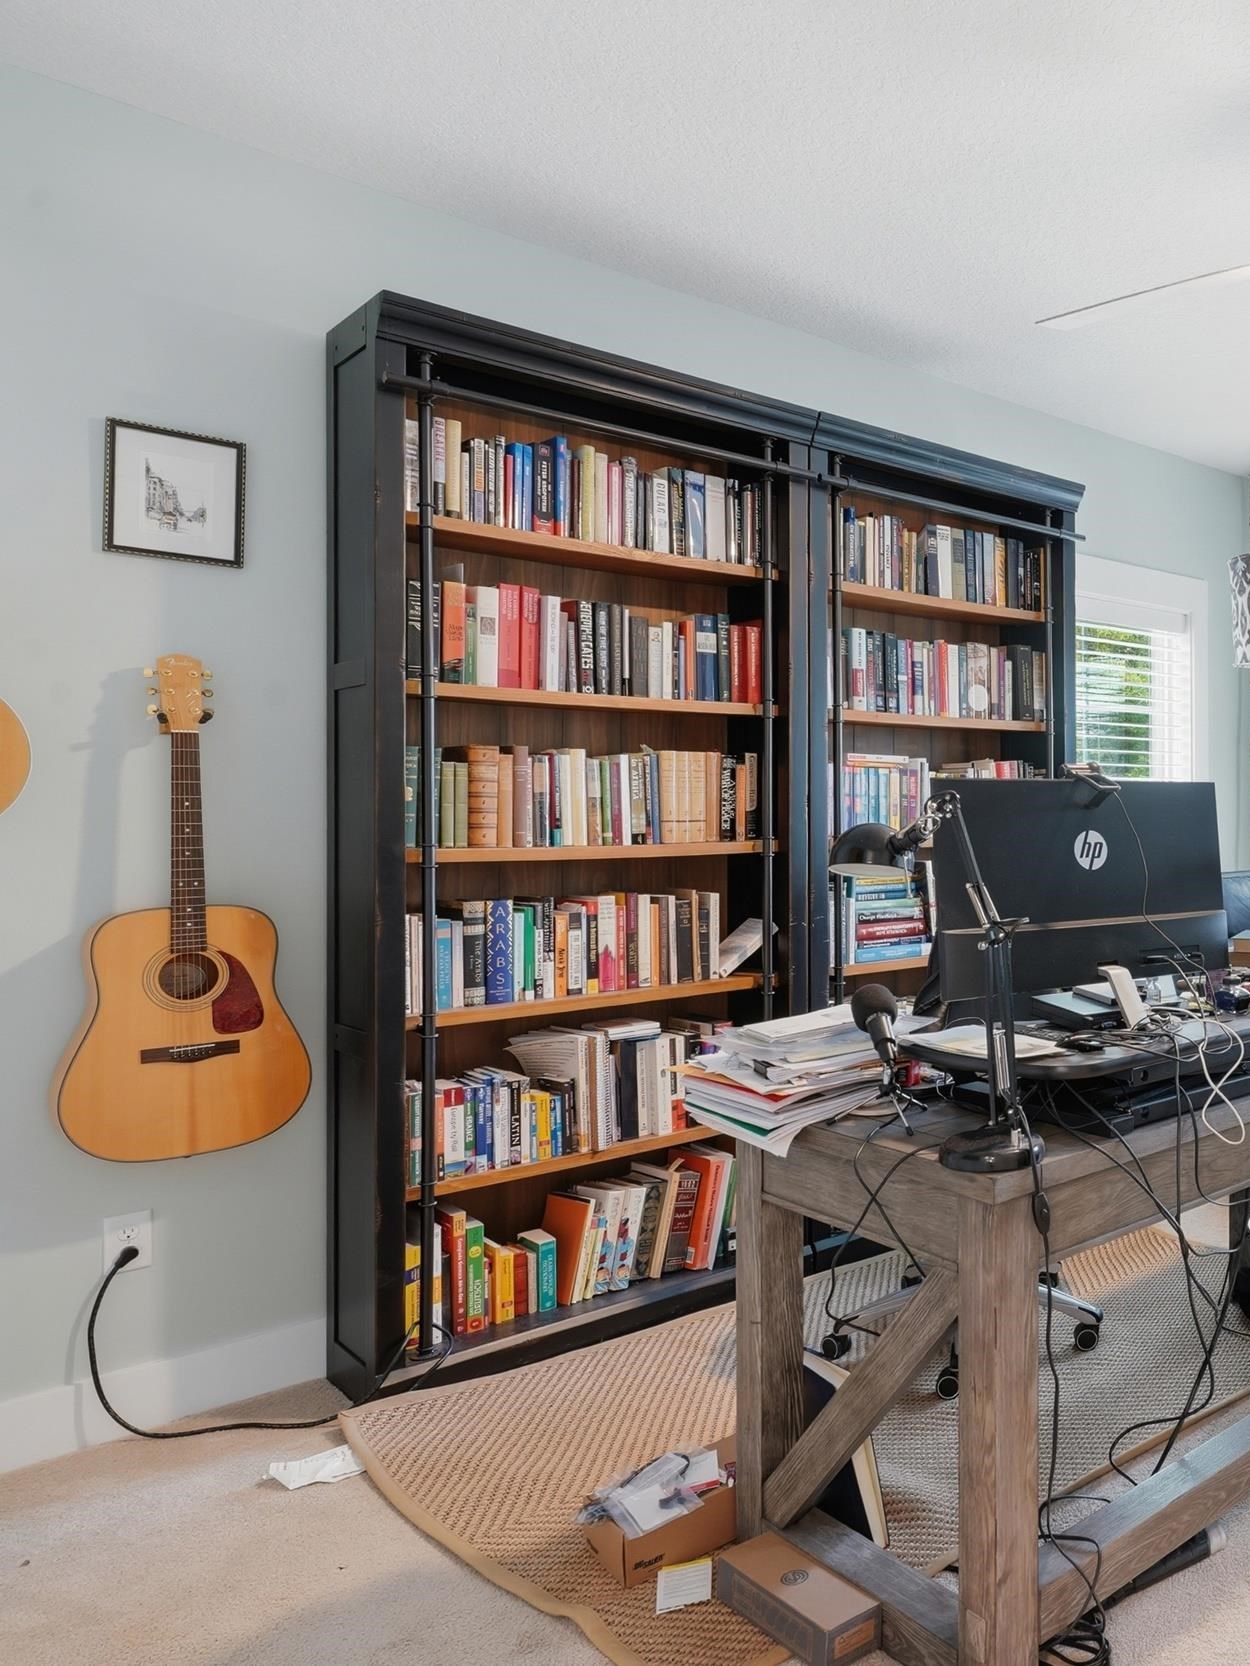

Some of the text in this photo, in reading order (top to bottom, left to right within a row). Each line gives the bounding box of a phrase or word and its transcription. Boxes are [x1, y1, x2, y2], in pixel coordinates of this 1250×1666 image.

[435, 420, 445, 464] BREATHE
[656, 482, 666, 514] GULAG
[721, 769, 731, 830] WAR OF PEACE
[1078, 830, 1105, 870] hp
[495, 907, 506, 985] ARABS
[450, 1108, 458, 1130] Europe
[450, 1131, 458, 1139] by
